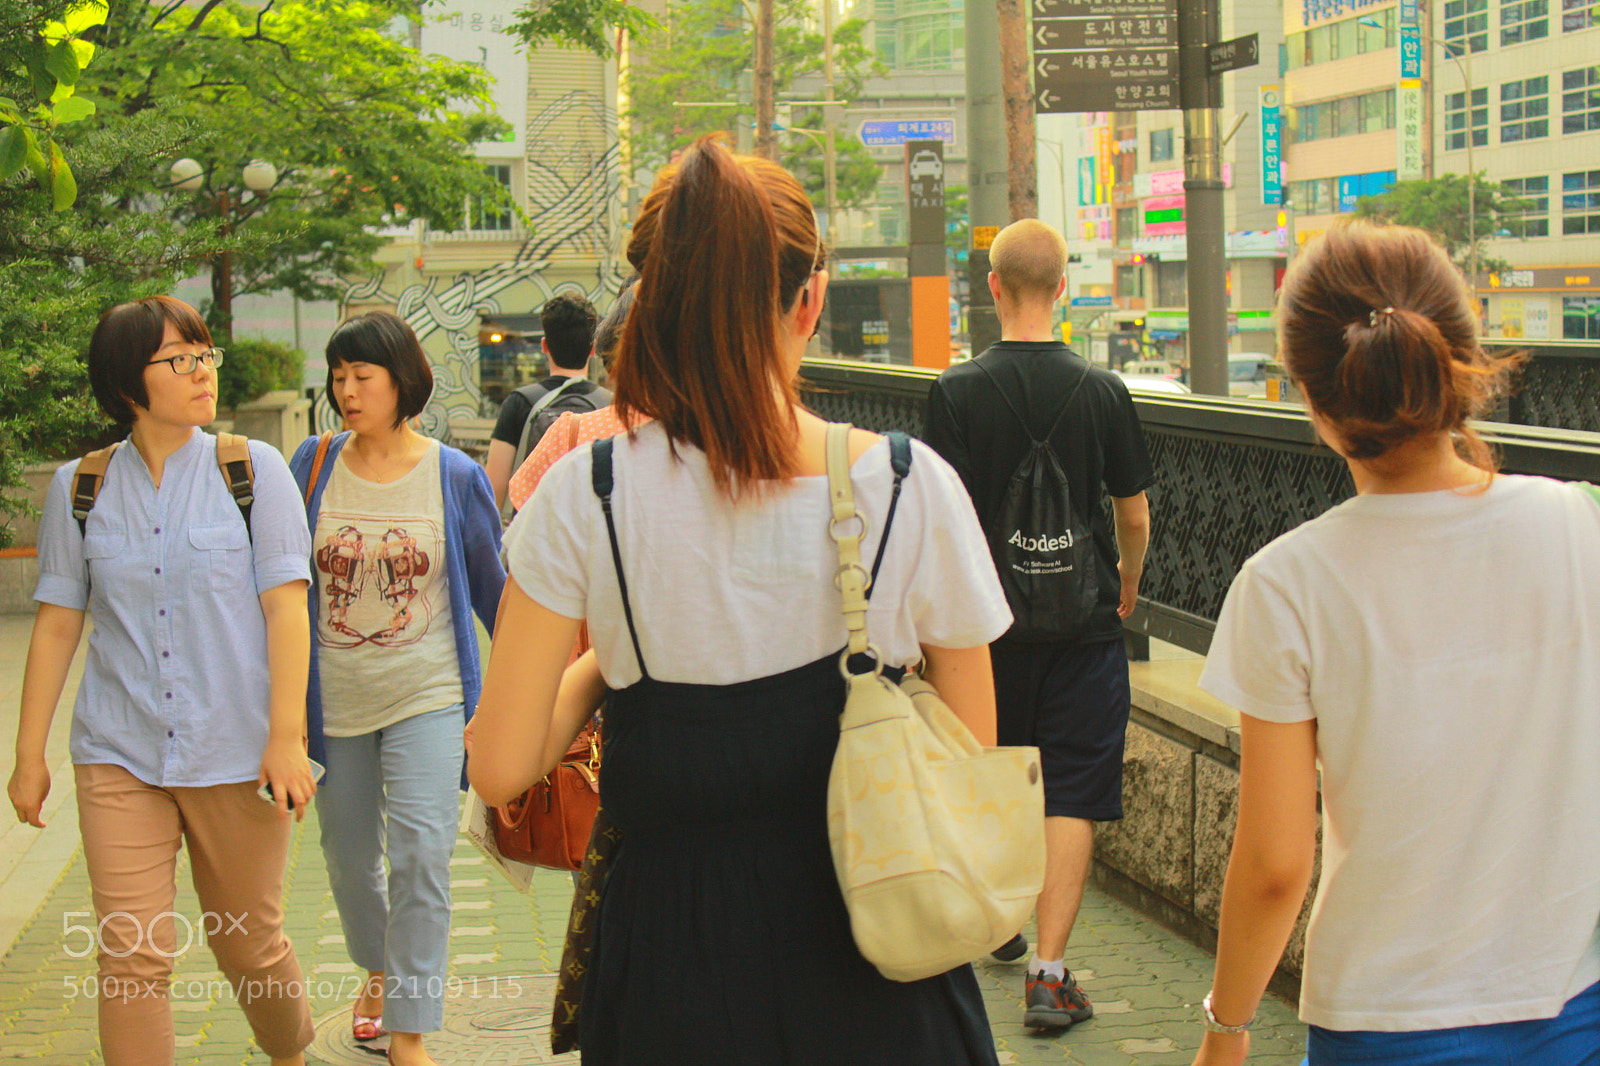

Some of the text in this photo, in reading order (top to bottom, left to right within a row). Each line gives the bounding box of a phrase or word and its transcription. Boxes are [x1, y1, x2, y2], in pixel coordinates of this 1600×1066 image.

[451, 12, 503, 32] 미용실
[1084, 18, 1168, 36] 도시안전실
[1071, 52, 1168, 70] 서울유스호스텔
[1145, 99, 1170, 108] Church
[1264, 123, 1279, 184] 푸른안과
[910, 182, 944, 197] 택시
[913, 198, 944, 208] TAXI
